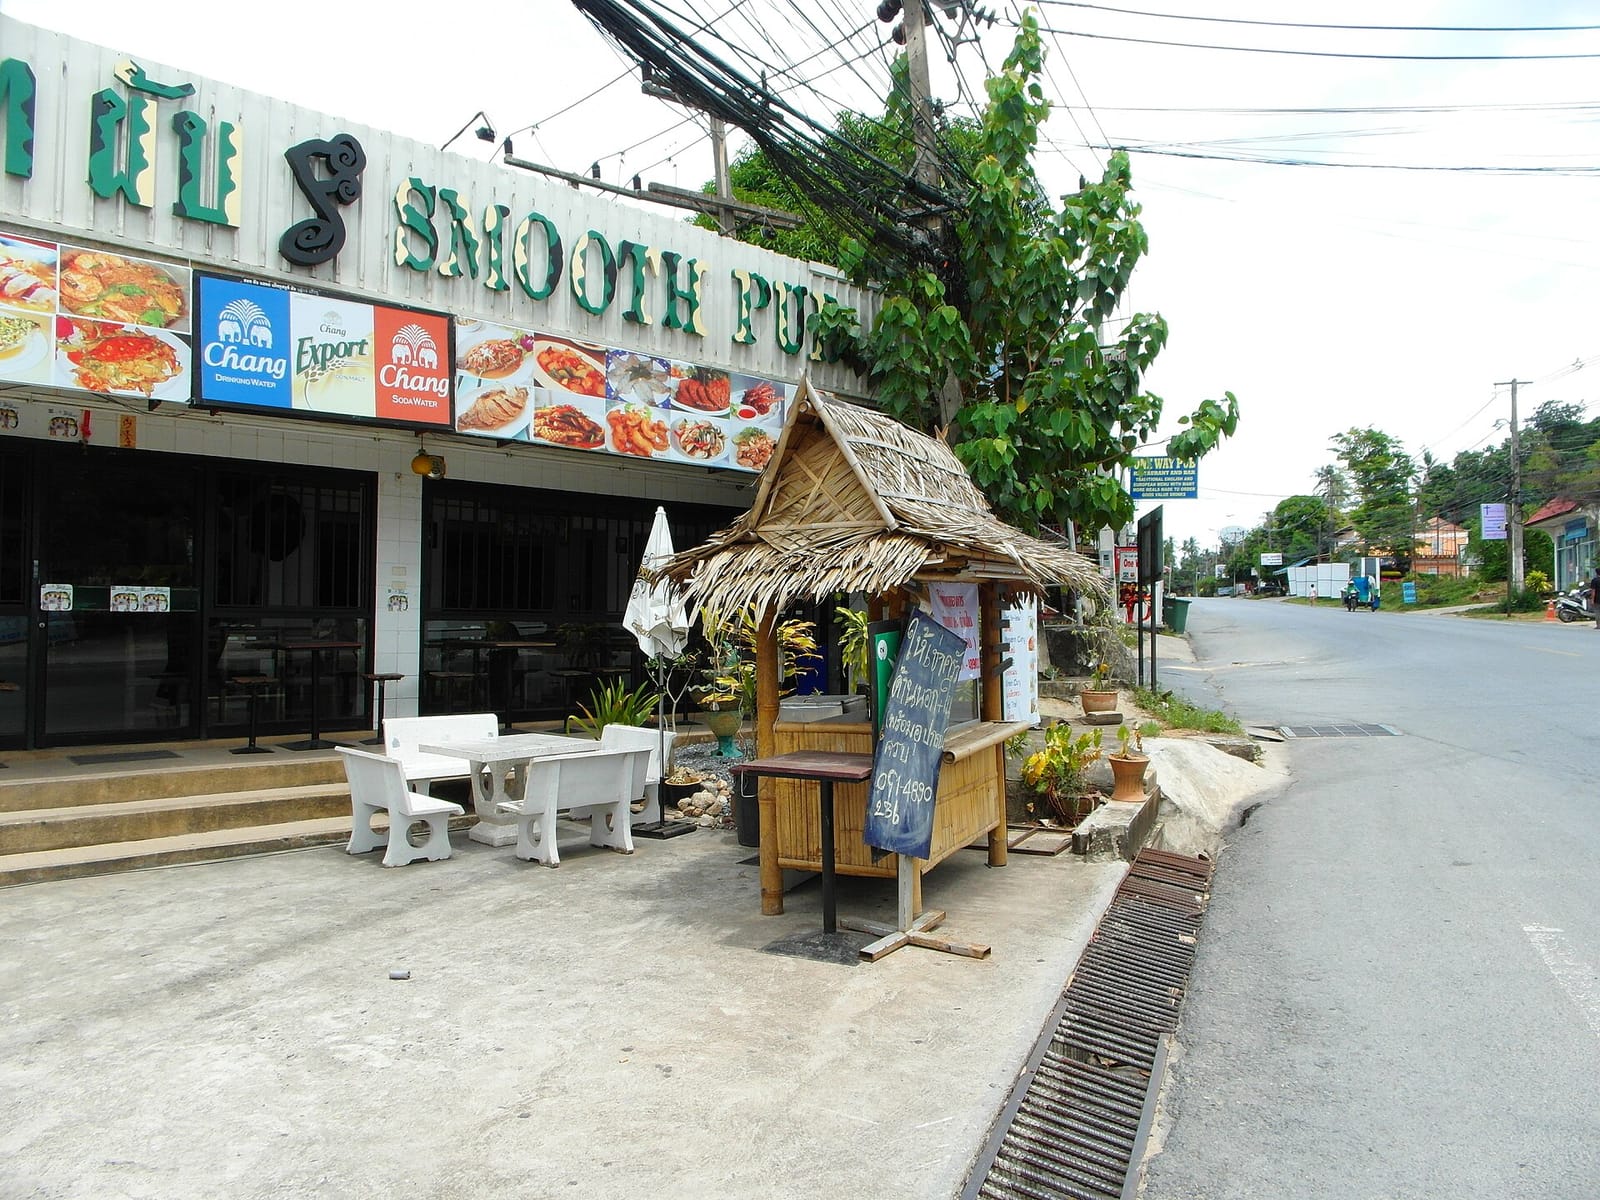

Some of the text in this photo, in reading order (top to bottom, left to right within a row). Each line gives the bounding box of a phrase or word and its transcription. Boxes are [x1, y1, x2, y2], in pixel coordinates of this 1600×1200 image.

[393, 176, 708, 338] SMOOTH
[319, 323, 347, 337] Chang
[204, 341, 287, 379] Chang
[296, 336, 369, 375] Export
[215, 373, 277, 389] DRINKING WATER
[379, 364, 449, 397] Chang
[391, 395, 438, 408] SODA WATER
[1154, 457, 1176, 469] WAY
[873, 800, 900, 825] 236
